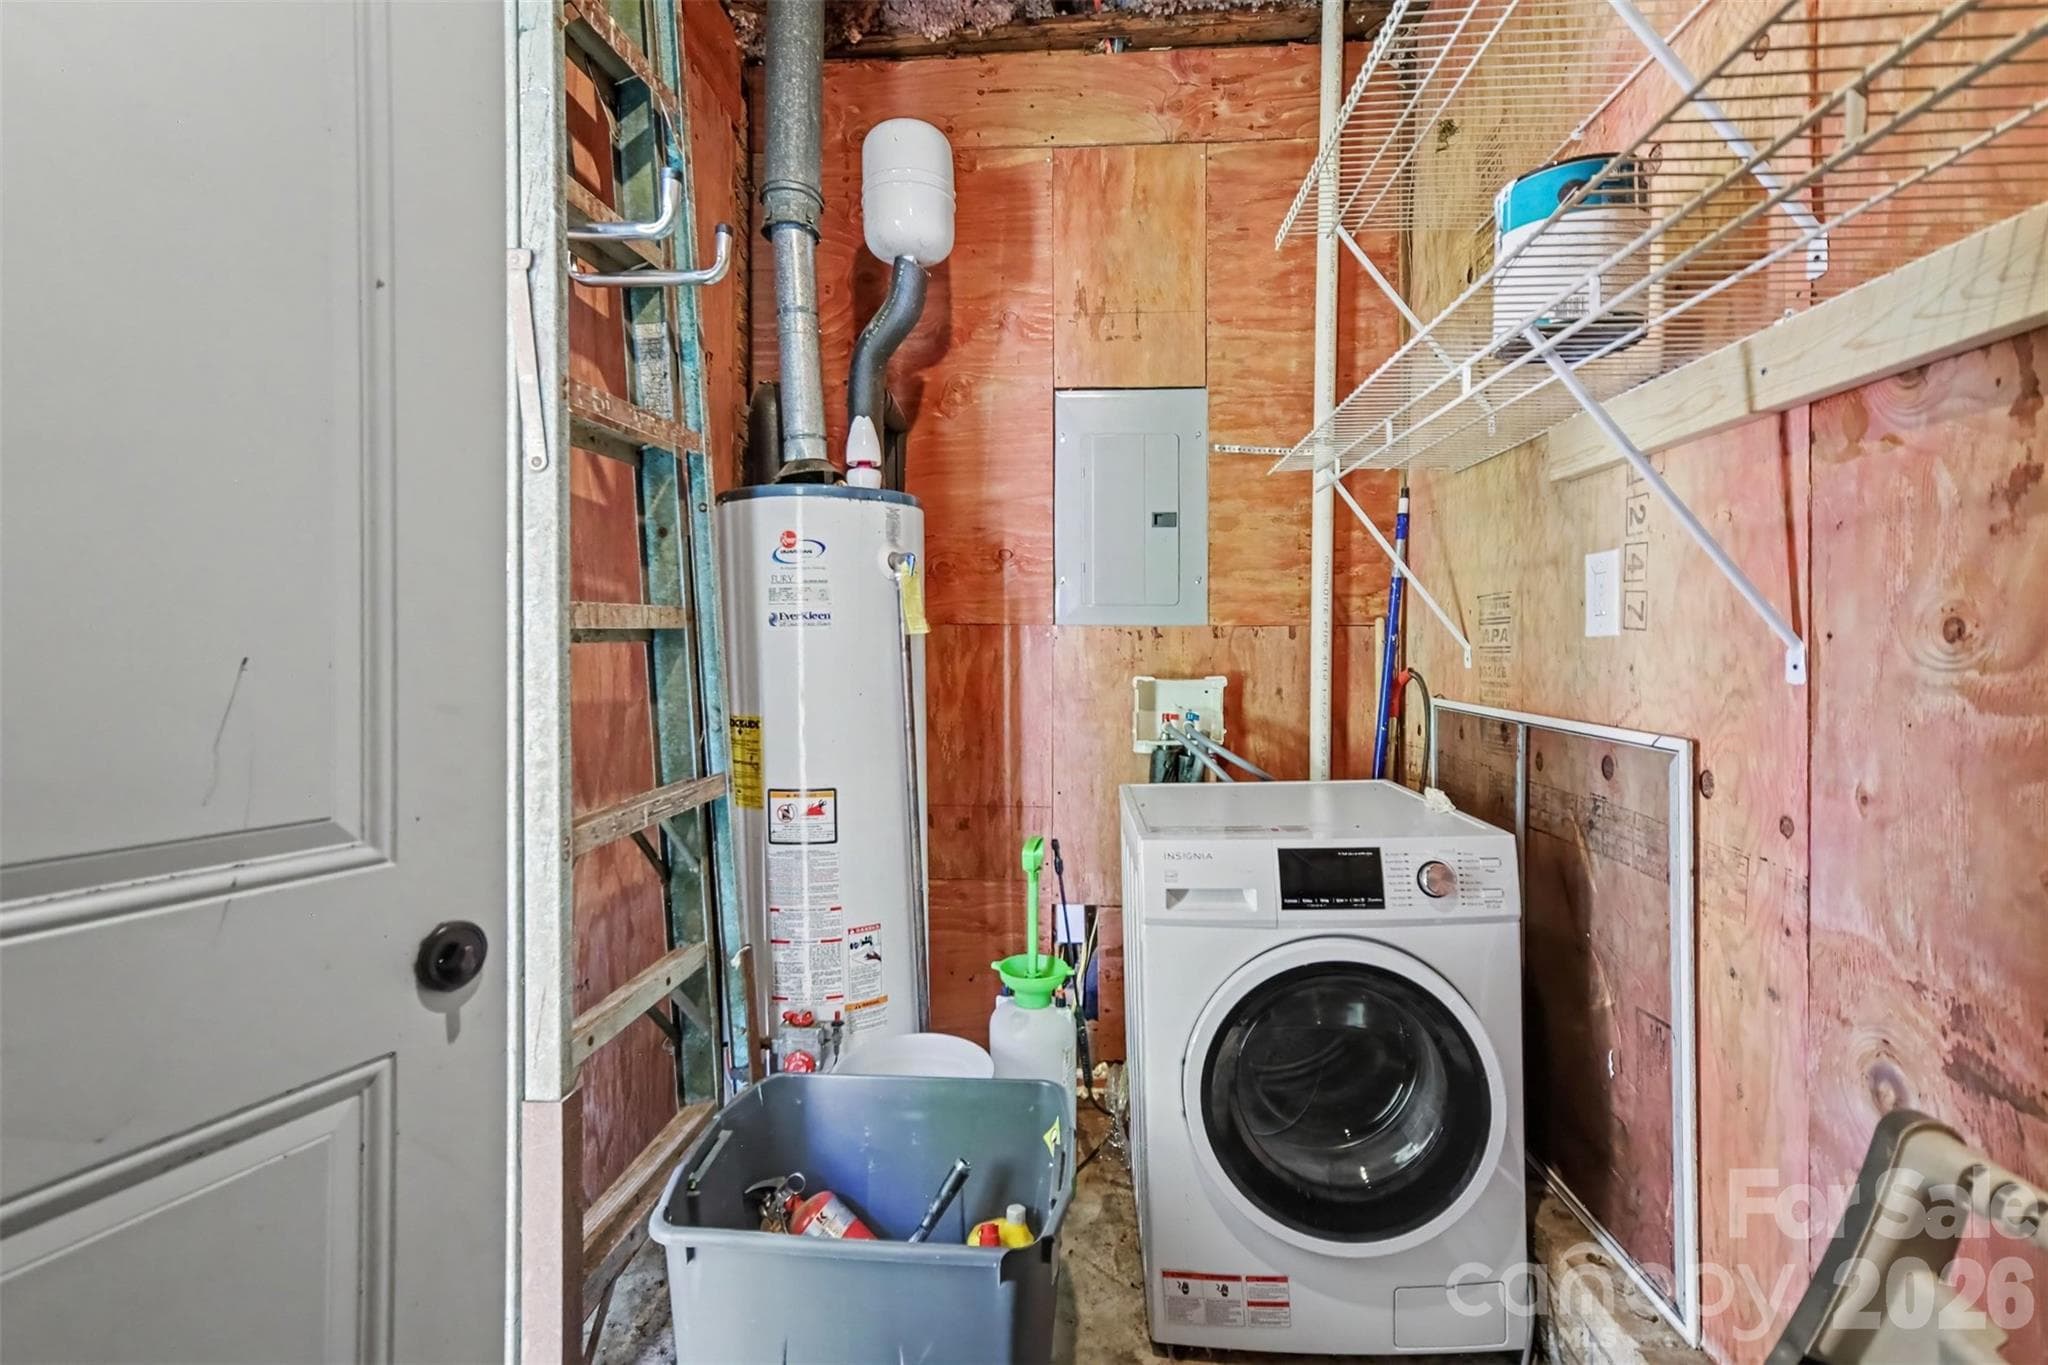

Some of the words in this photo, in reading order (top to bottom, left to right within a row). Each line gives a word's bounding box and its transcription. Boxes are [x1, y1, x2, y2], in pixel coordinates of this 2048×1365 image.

[1629, 504, 1647, 527] 2
[1627, 553, 1645, 574] 4
[1627, 600, 1645, 622] 7
[1482, 628, 1509, 642] APA
[1163, 852, 1214, 860] INSIGNIA
